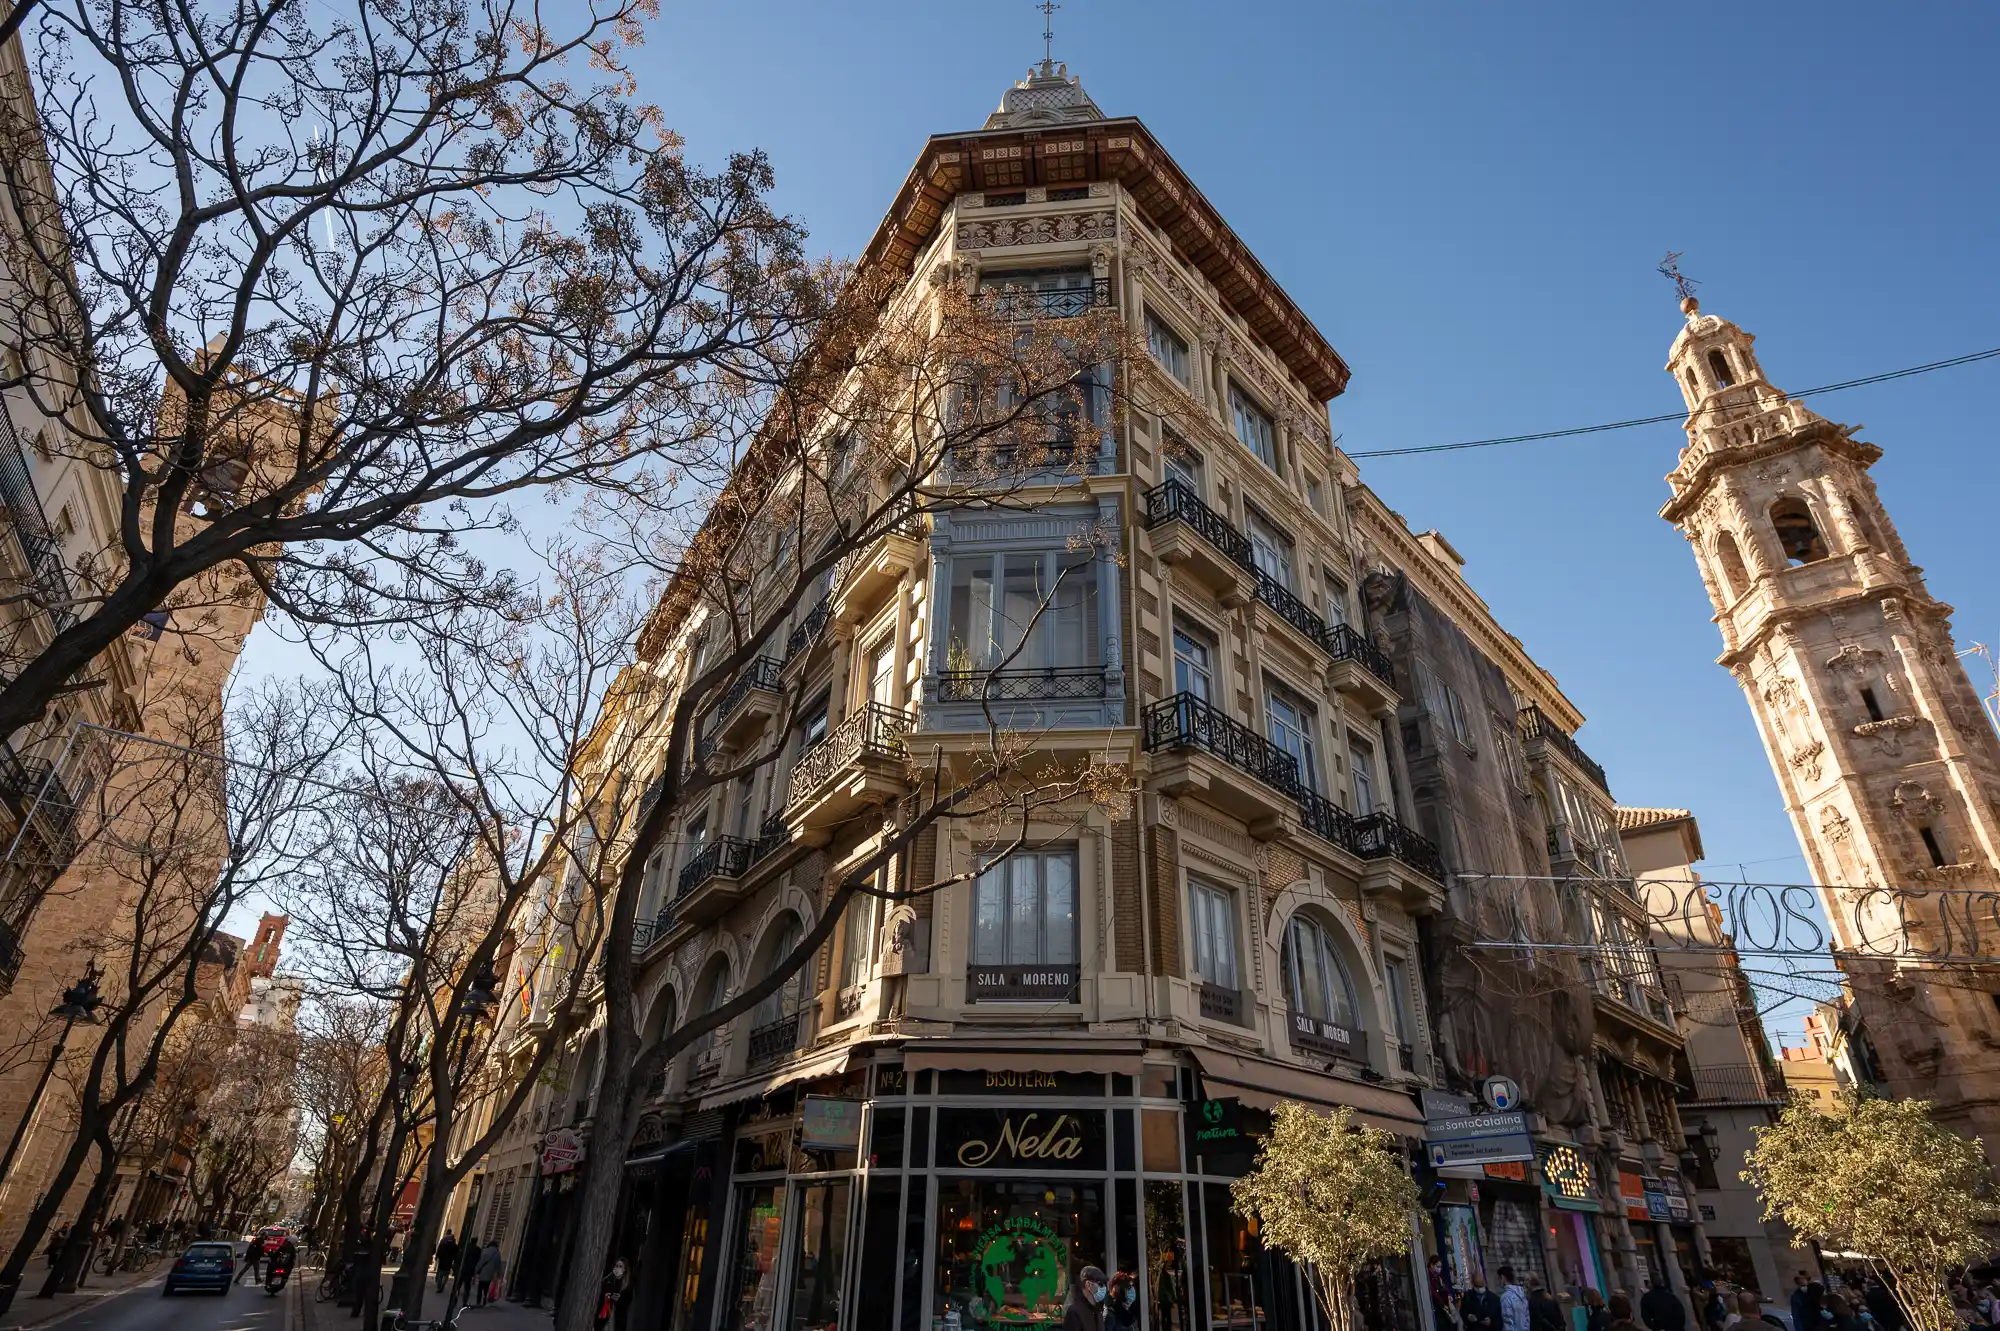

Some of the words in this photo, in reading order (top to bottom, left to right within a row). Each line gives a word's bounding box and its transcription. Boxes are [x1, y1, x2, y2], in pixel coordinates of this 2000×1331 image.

[977, 973, 1005, 986] SALA
[1022, 973, 1069, 986] MORENO
[1296, 1016, 1315, 1035] SALA
[1323, 1024, 1350, 1045] MORENO
[1445, 1115, 1521, 1131] SantaCatalina
[957, 1112, 1083, 1168] Nela
[1196, 1127, 1239, 1141] natura
[1544, 1146, 1590, 1188] WAFFLE
[1559, 1177, 1586, 1197] TIME
